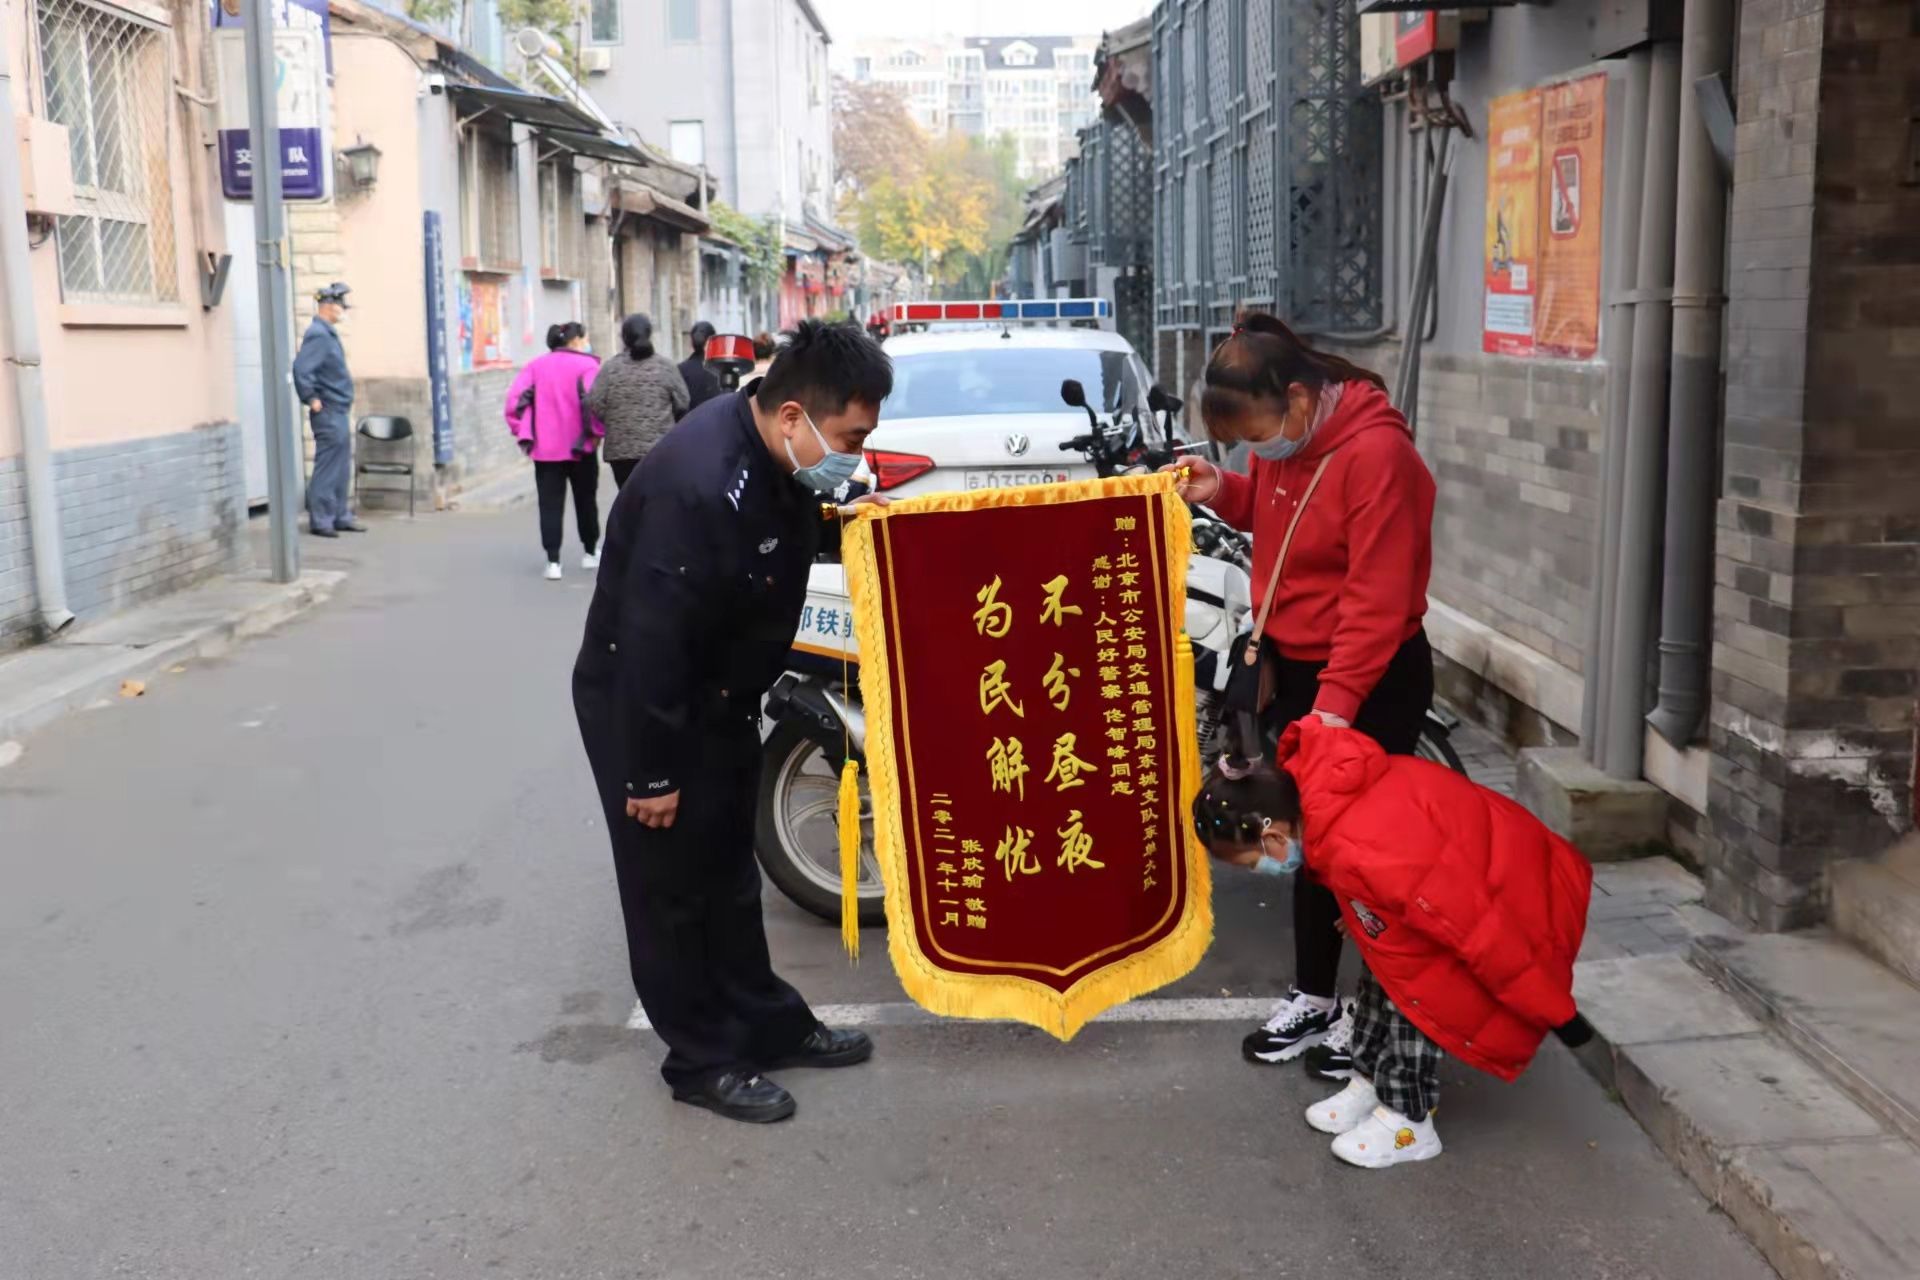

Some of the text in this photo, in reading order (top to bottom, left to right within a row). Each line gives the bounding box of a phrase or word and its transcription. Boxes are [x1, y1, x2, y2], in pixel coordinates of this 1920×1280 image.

[648, 779, 670, 789] POLICE
[973, 574, 1041, 882] 为民解忧
[1040, 574, 1105, 874] 不分昼夜
[930, 793, 960, 927] 二零二一年十一月
